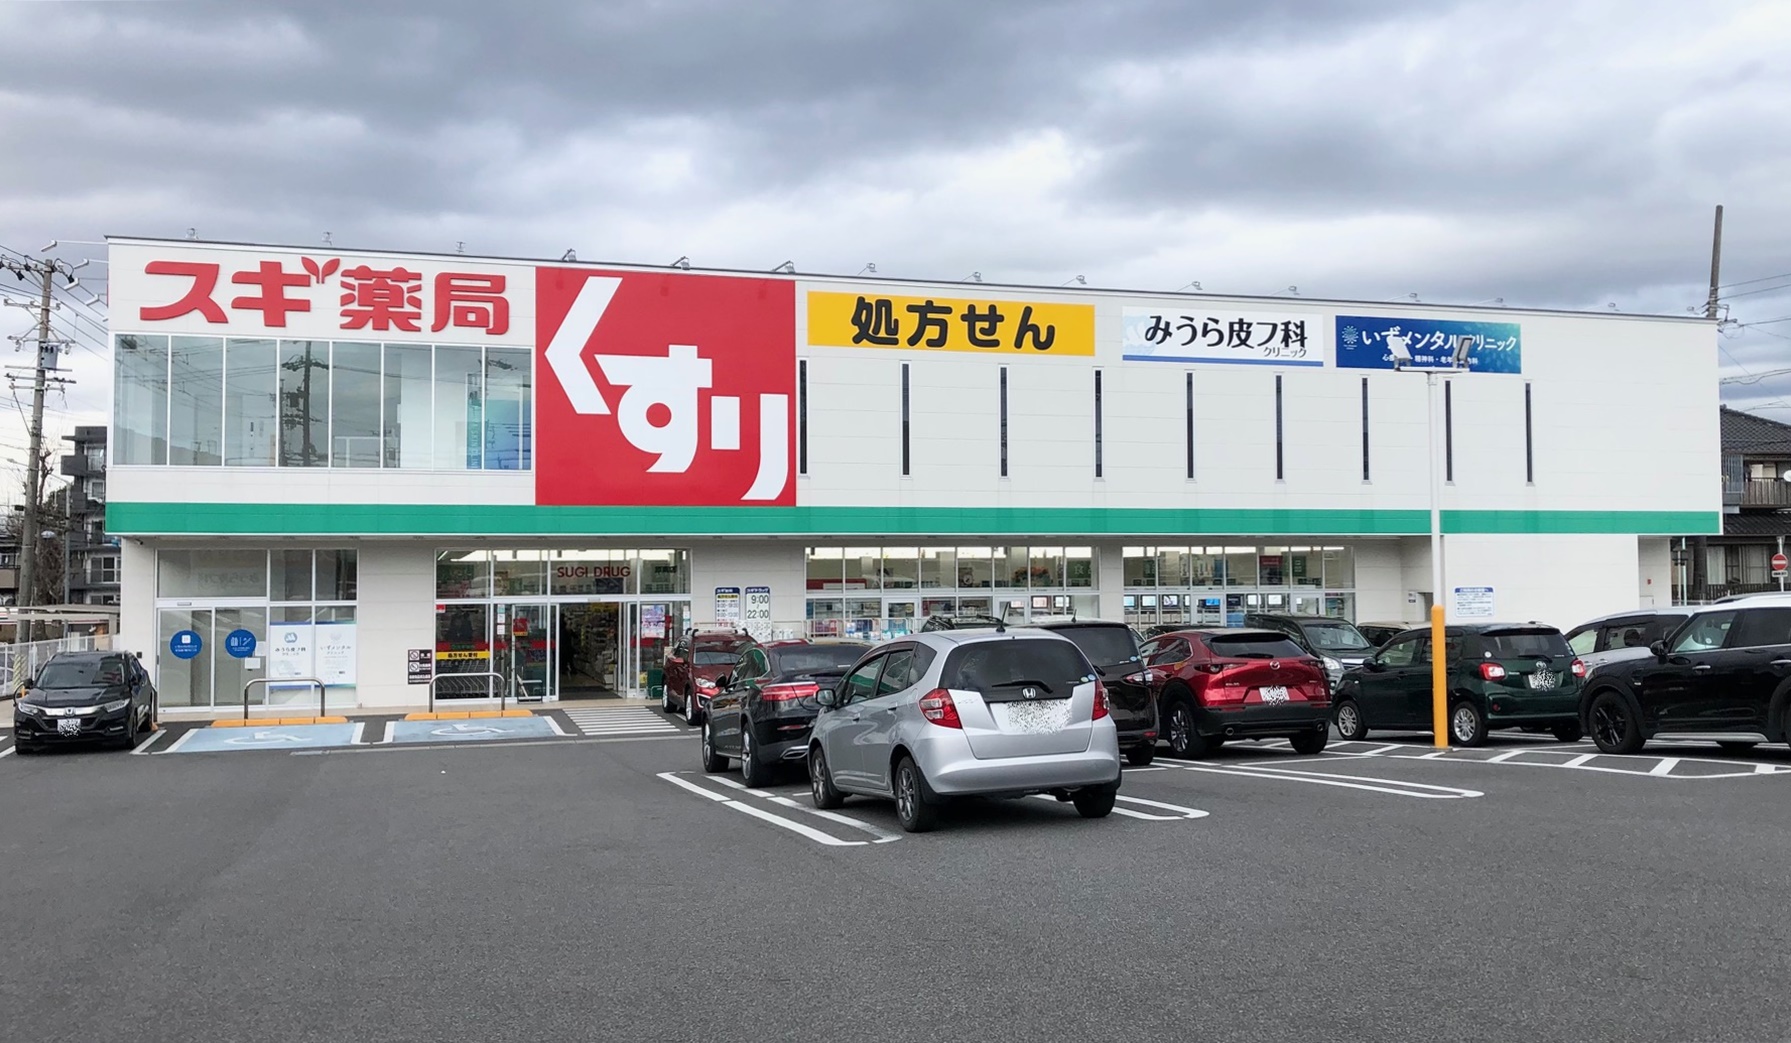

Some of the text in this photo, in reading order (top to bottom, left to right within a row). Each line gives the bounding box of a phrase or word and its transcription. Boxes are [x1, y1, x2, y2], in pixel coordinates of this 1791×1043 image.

[140, 257, 509, 335] スギ薬局
[851, 297, 1055, 351] 処方せん
[1145, 315, 1307, 349] みうら皮フ科
[1263, 346, 1306, 358] クリニック
[544, 276, 788, 500] くすり
[557, 566, 631, 578] SUGI DRUG
[751, 594, 769, 604] 9:00
[747, 609, 769, 619] 22:00
